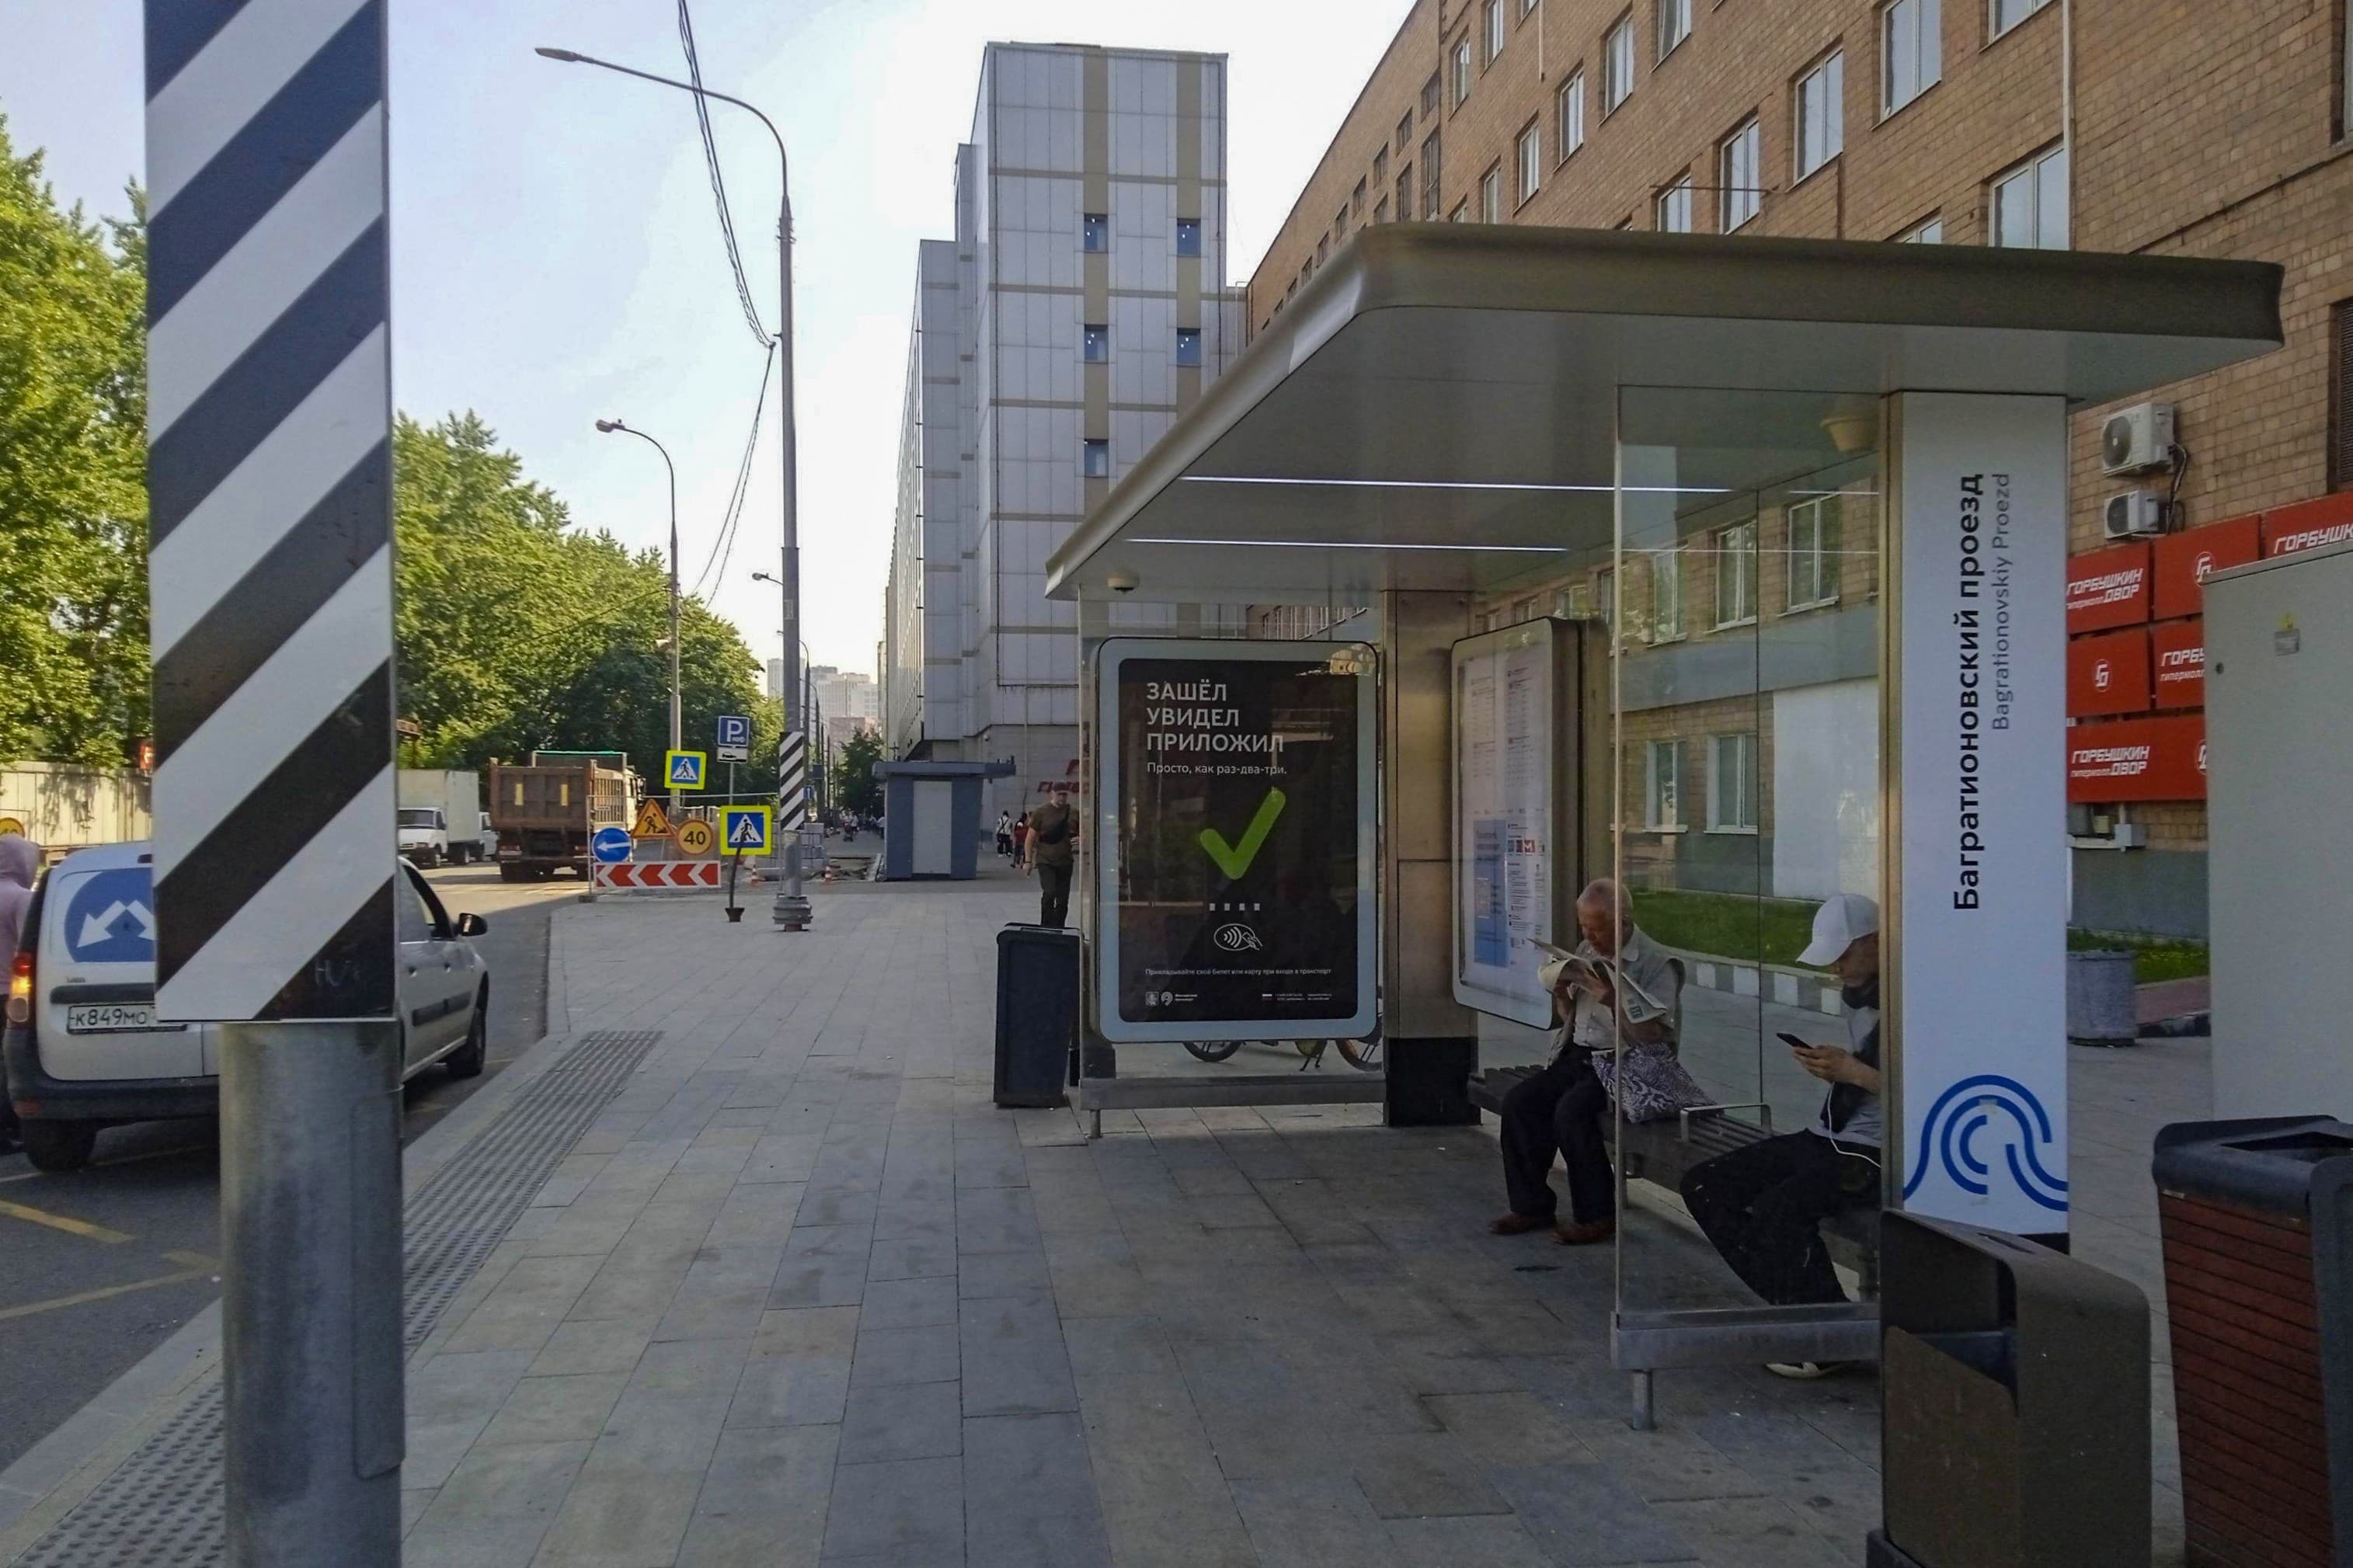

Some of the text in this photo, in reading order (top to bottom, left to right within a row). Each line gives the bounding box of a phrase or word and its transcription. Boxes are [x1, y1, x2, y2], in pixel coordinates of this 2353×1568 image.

[2066, 568, 2143, 596] ГОРБУШКИН
[1990, 474, 2014, 729] Bagrationovskiy Proezd
[1147, 679, 1227, 701] ЗАШЁЛ
[1953, 474, 1985, 909] Багратионовский проезд
[1147, 708, 1239, 729] УВИДЕЛ
[727, 720, 743, 742] P
[1147, 733, 1283, 753] ПРИЛОЖИЛ
[2072, 746, 2150, 764] ГОРБУШКИН
[1147, 762, 1287, 776] Просто, как раз-два-три.
[684, 830, 706, 846] 40
